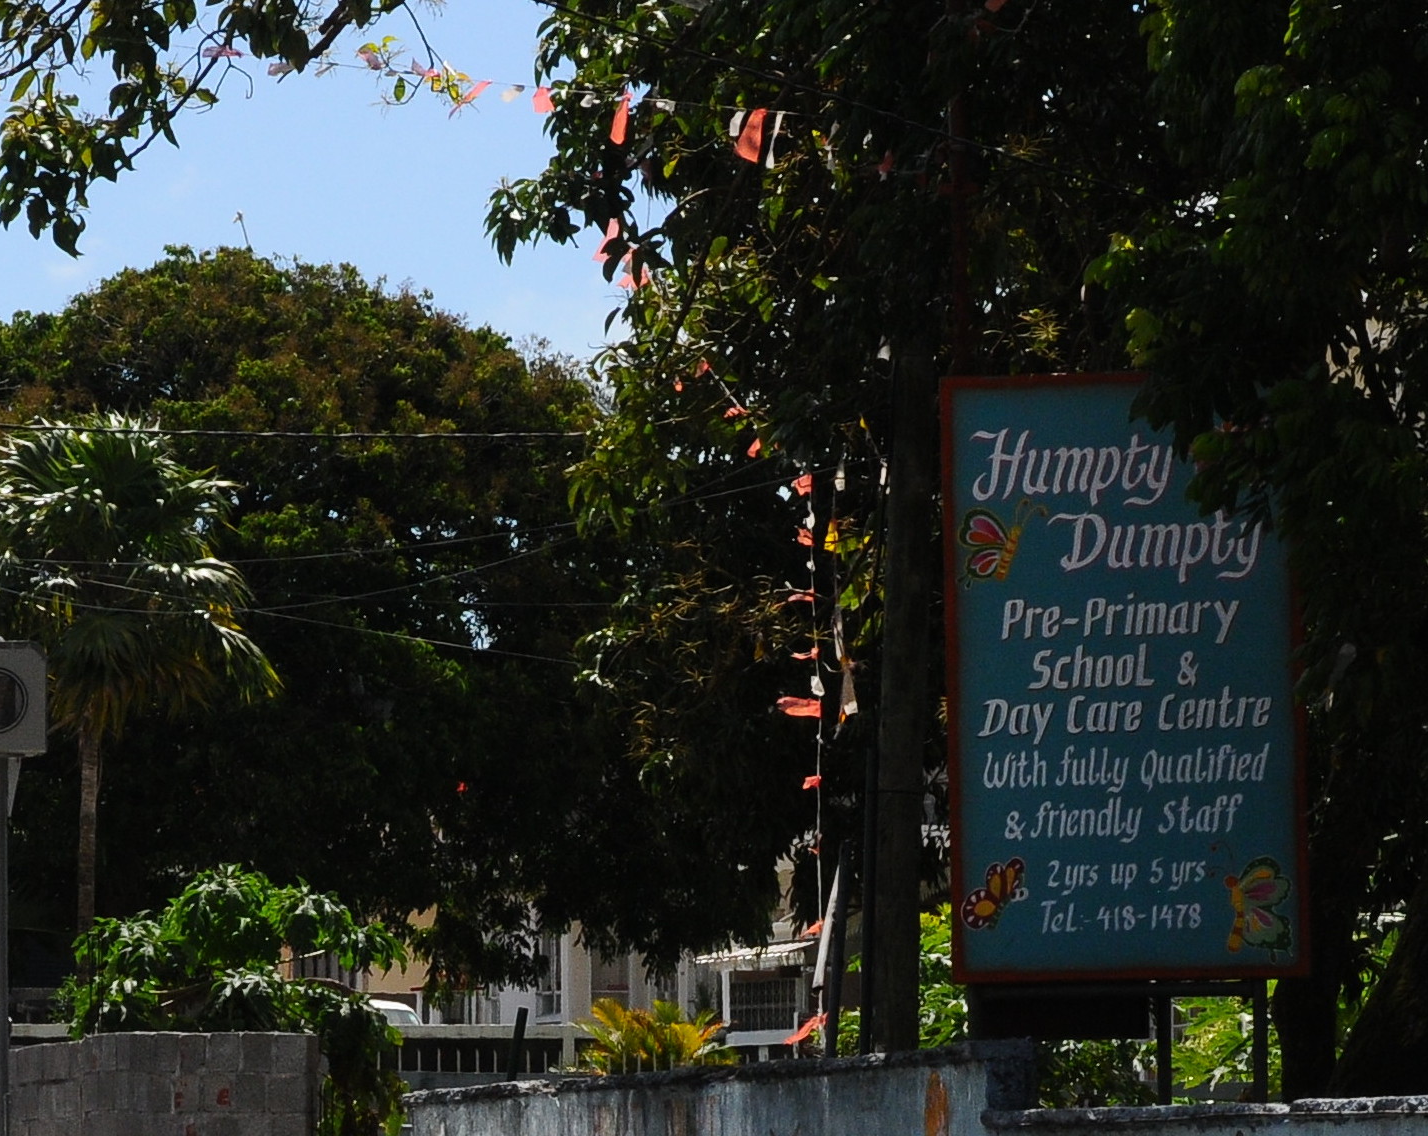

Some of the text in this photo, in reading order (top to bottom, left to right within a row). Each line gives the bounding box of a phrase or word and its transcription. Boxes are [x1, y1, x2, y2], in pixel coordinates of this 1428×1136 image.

[970, 427, 1173, 506] Humpty
[1047, 509, 1262, 583] Dumpty
[1001, 592, 1240, 645] Pre-Primary
[1176, 650, 1199, 686] &
[977, 686, 1272, 745] Day Care Centre
[983, 743, 1271, 793] With fully Qualified
[1004, 810, 1025, 841] &
[1030, 797, 1143, 844] friendly
[1111, 862, 1138, 891] up
[1150, 857, 1164, 884] 5
[1168, 860, 1207, 892] yrs
